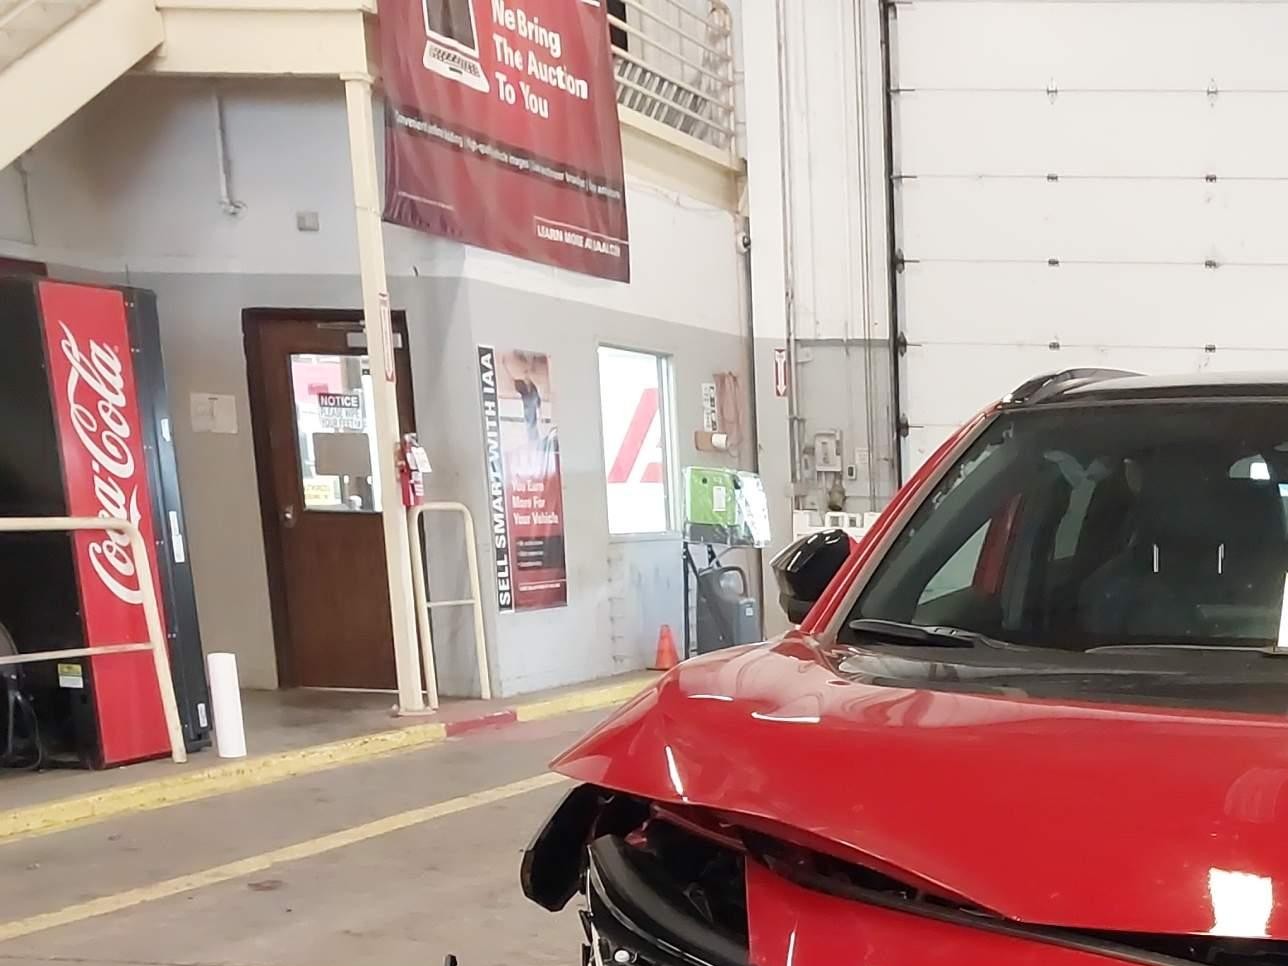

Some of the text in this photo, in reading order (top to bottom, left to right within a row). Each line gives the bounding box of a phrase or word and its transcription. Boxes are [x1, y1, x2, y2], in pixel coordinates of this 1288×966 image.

[517, 8, 562, 58] Bring
[493, 33, 588, 100] The Auction
[495, 72, 549, 119] To You
[320, 395, 359, 408] NOTICE
[59, 320, 143, 605] Coca-Cola
[480, 352, 511, 606] SELL SMART WITH IAA
